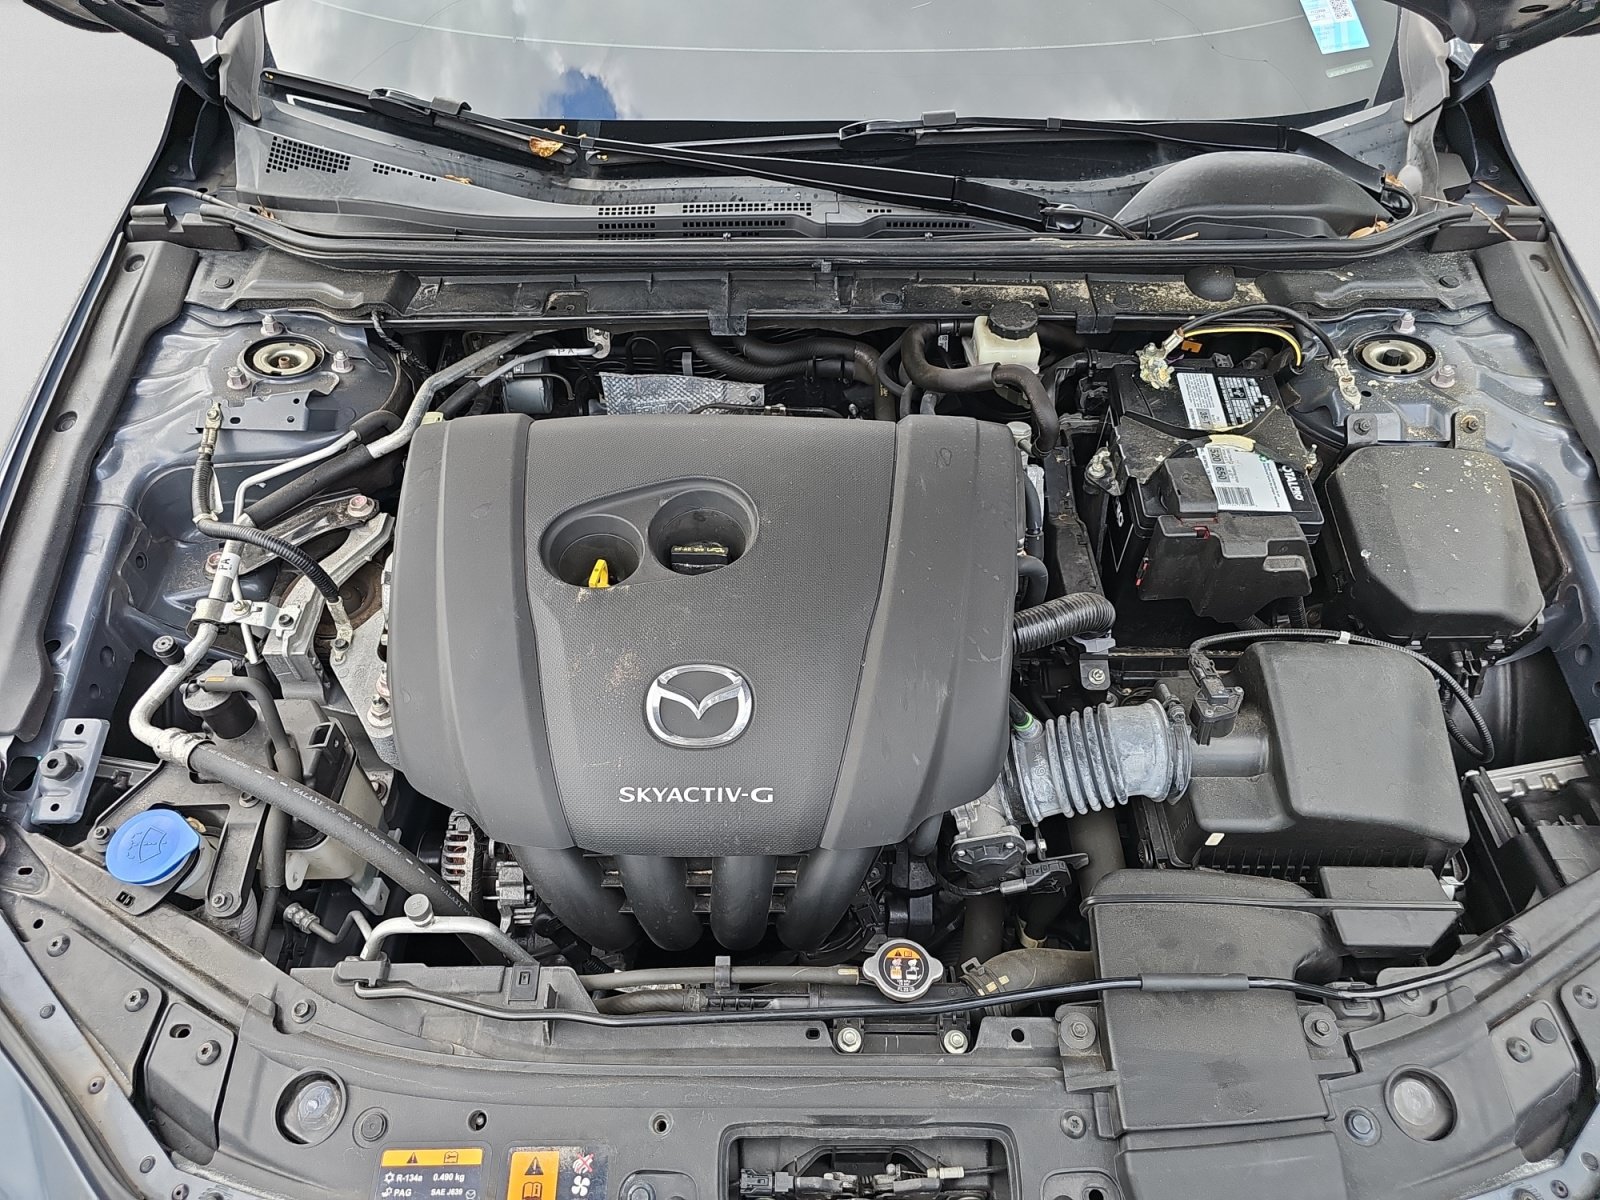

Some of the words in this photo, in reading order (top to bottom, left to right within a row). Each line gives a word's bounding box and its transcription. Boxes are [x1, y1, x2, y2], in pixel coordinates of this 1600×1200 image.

[1209, 448, 1222, 462] 520
[1215, 466, 1227, 480] 650
[1281, 464, 1304, 502] OTALPRO
[293, 787, 324, 806] GALAXY
[618, 786, 774, 803] SKYACTIV-G
[440, 885, 464, 908] GALAXY
[396, 1174, 423, 1183] R-134a
[433, 1173, 454, 1182] 0.490
[454, 1173, 465, 1183] kg
[393, 1188, 412, 1197] PAG
[430, 1188, 446, 1197] SAE
[446, 1188, 464, 1197] J639
